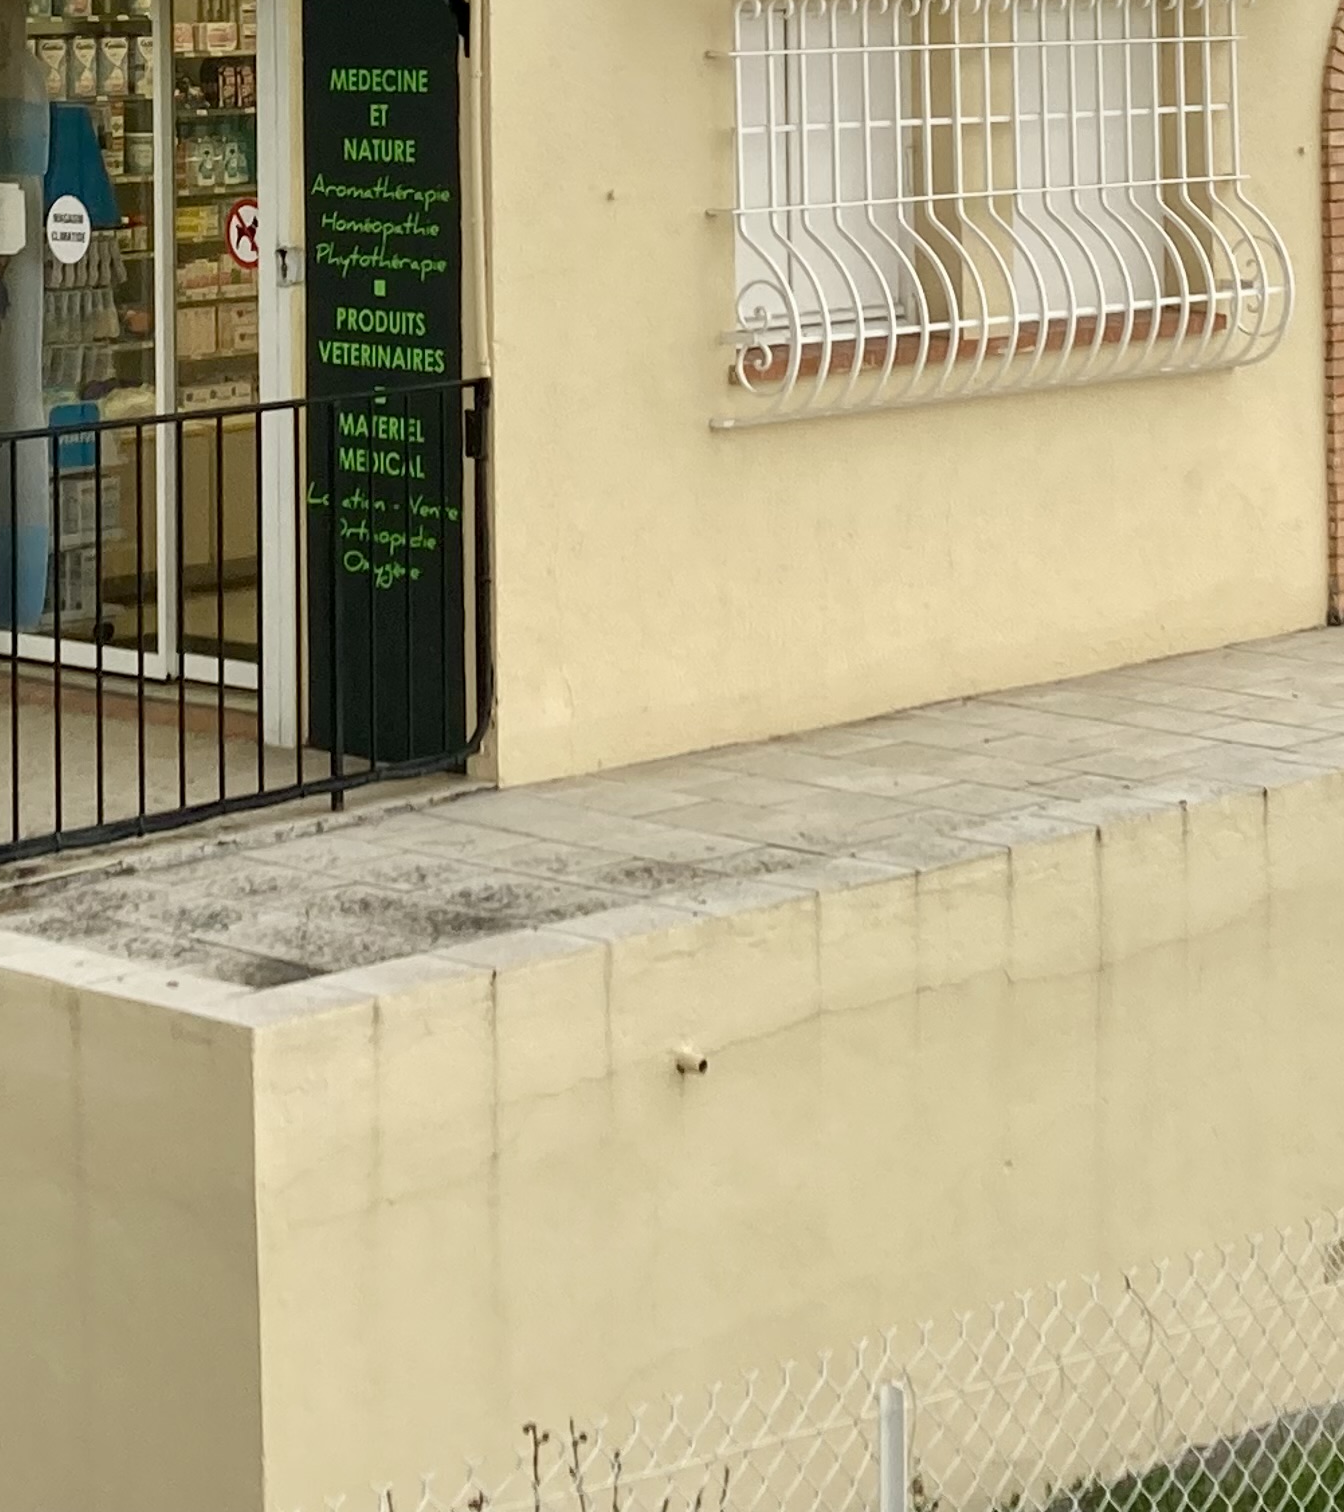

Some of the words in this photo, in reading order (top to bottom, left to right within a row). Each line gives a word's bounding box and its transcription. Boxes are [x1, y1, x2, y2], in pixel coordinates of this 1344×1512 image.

[330, 68, 429, 93] MEDECINE
[369, 104, 389, 127] ET
[344, 139, 416, 163] NATURE
[336, 307, 426, 337] PRODUITS
[318, 340, 446, 374] VETERINAIRES
[338, 411, 425, 443] MATERIEL
[307, 481, 386, 512] Loation
[408, 494, 459, 522] Vene
